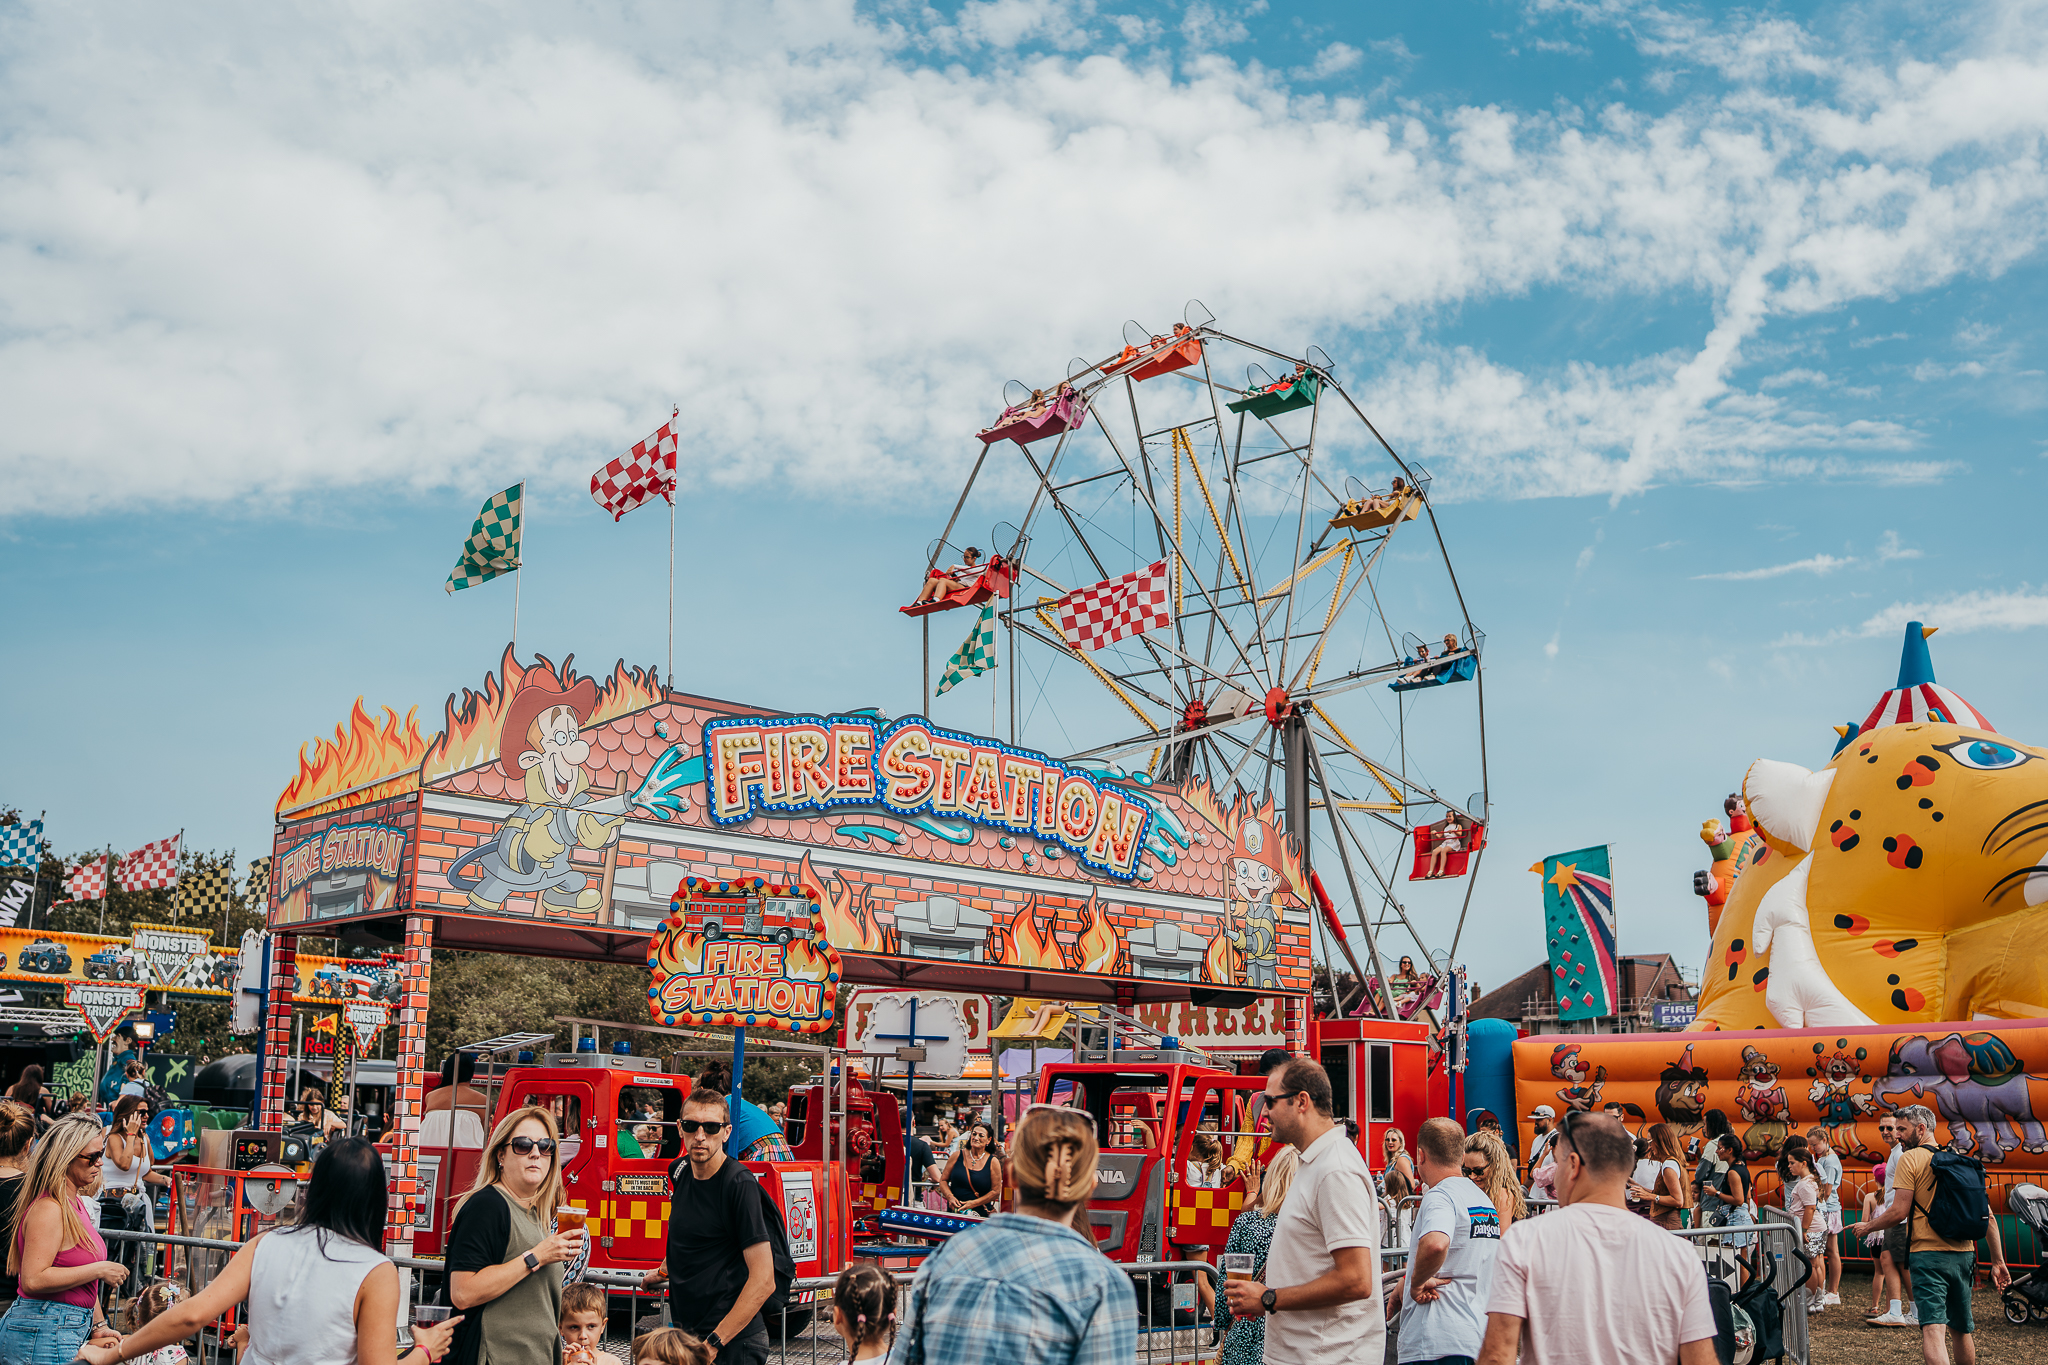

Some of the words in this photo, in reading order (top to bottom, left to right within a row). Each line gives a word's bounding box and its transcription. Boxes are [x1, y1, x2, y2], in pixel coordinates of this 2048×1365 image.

[714, 728, 876, 814] FIRE
[880, 728, 1146, 869] STATION
[281, 835, 323, 898] FIRE
[321, 826, 405, 878] STATION
[133, 934, 207, 954] MONSTER
[149, 950, 189, 966] TRUCKS
[705, 941, 783, 977] FIRE
[68, 990, 141, 1007] MONSTER
[663, 974, 821, 1017] STATION
[1139, 999, 1286, 1037] WHEEL
[1661, 1005, 1696, 1014] FIRE
[1662, 1014, 1696, 1024] EXIT
[305, 1036, 334, 1054] Red
[1095, 1170, 1127, 1184] NIA
